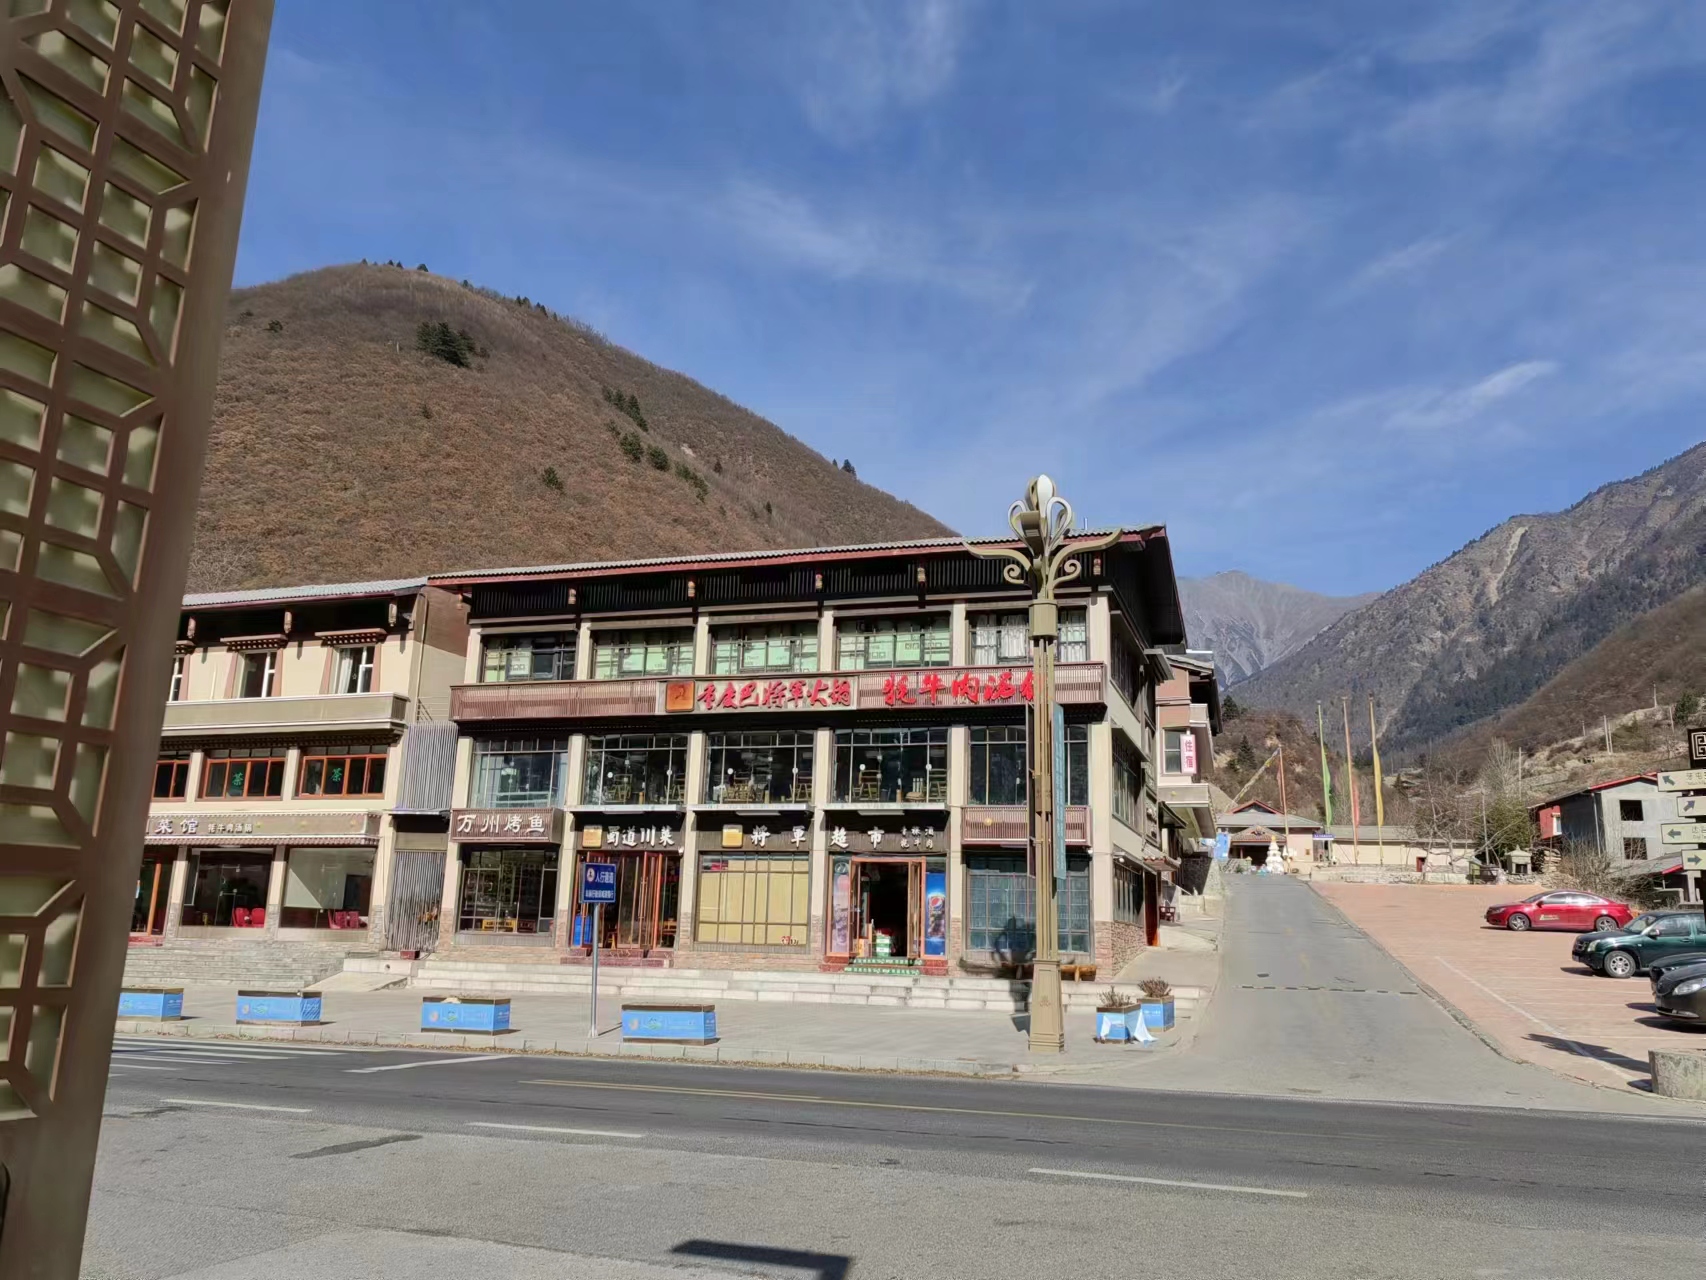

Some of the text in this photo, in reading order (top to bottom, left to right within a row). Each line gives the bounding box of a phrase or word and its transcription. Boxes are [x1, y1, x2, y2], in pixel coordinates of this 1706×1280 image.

[1185, 739, 1194, 769] 住宿
[233, 772, 244, 786] 茶
[331, 767, 342, 782] 茶
[457, 814, 545, 833] 万州烤鱼
[606, 825, 675, 847] 蜀道川菜
